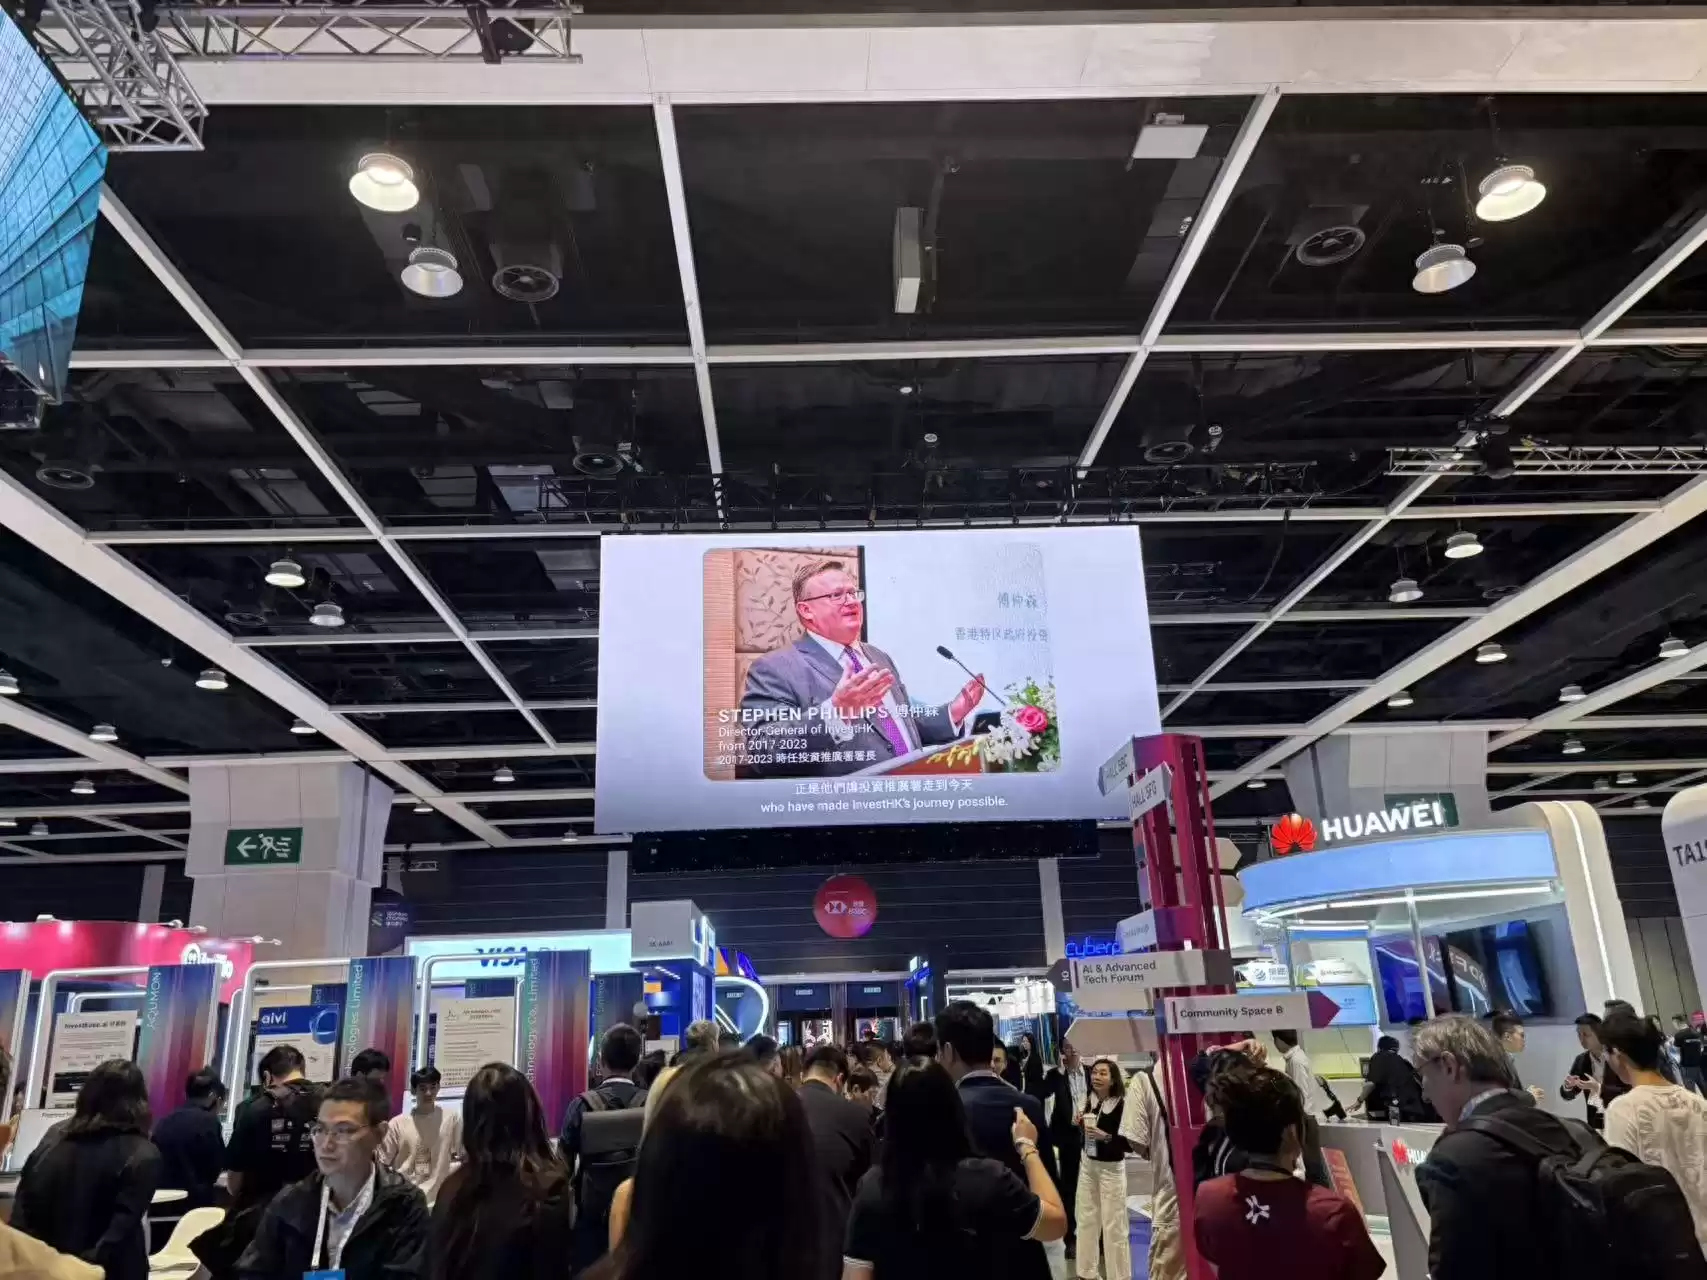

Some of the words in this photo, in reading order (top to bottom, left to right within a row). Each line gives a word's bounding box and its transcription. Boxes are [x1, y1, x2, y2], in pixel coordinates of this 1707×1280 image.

[718, 707, 801, 723] STEPHEN
[808, 704, 888, 720] PHILLIPS
[718, 724, 808, 738] Director-General
[811, 724, 822, 735] of
[825, 723, 875, 735] InvestHK
[718, 741, 746, 752] from
[748, 739, 808, 750] 2017-2023
[719, 754, 773, 765] 2017-2023
[761, 802, 785, 813] who
[787, 801, 814, 812] have
[818, 800, 849, 811] made
[912, 797, 955, 810] journey
[957, 796, 1008, 808] possible.
[1322, 800, 1443, 841] HUAWEI
[1672, 840, 1707, 867] TA1
[1082, 964, 1092, 974] AI
[1096, 962, 1103, 972] &
[1105, 960, 1157, 973] Advanced
[1083, 974, 1108, 985] Tech
[1111, 972, 1145, 984] Forum
[1180, 1006, 1238, 1018] Community
[1241, 1005, 1273, 1016] Space
[1276, 1005, 1284, 1014] B
